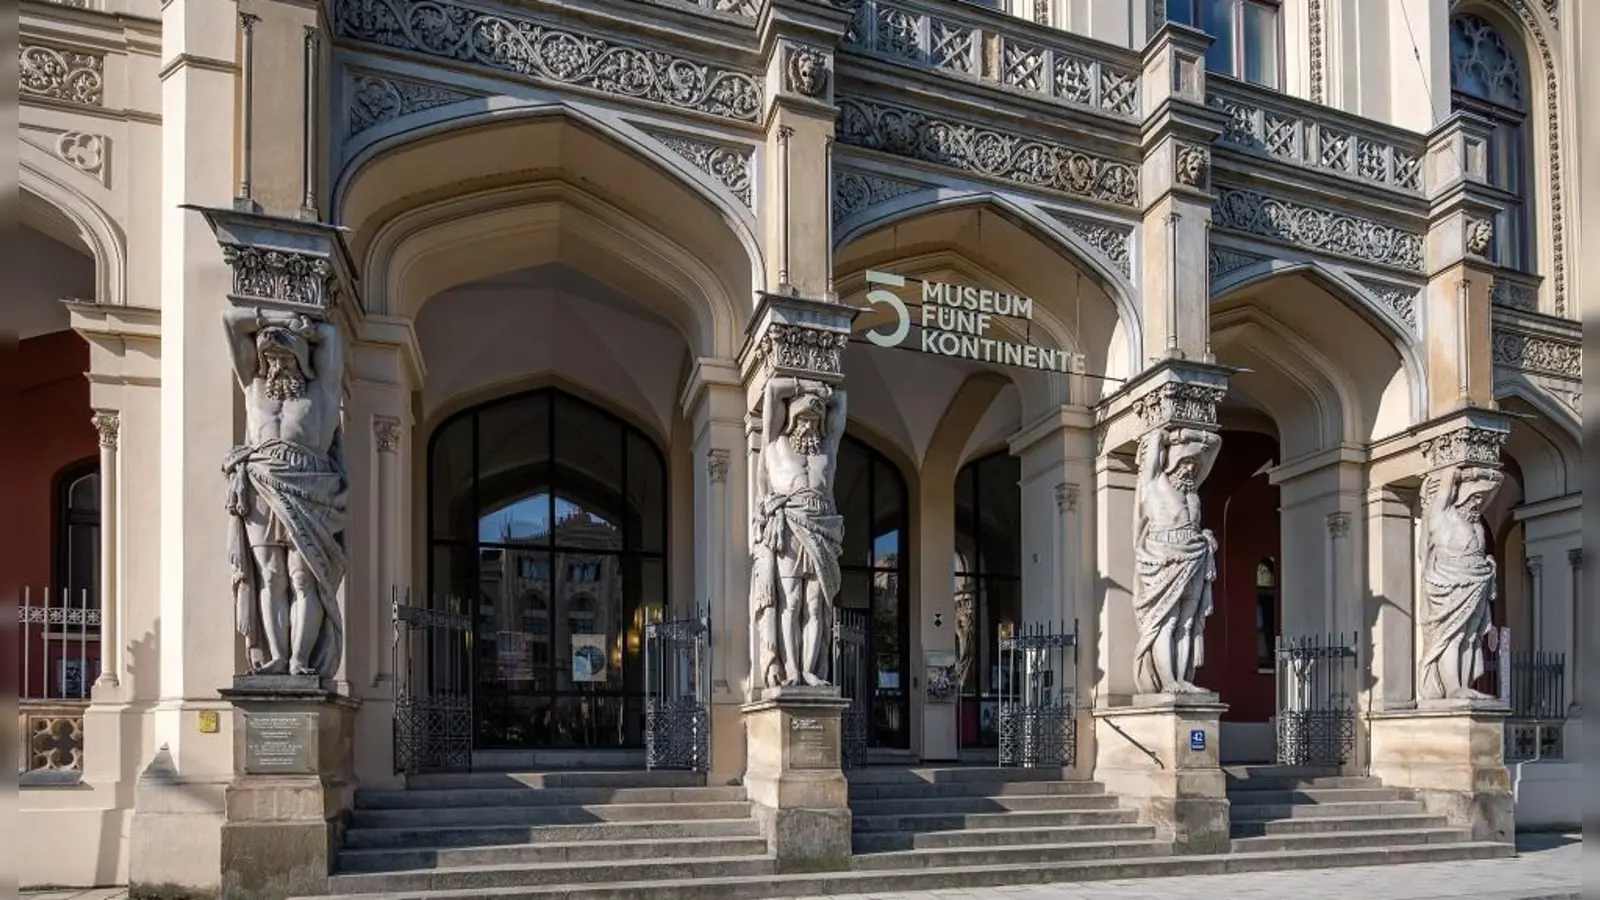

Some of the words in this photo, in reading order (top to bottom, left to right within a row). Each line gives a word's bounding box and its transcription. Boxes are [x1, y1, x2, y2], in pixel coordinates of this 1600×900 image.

[866, 270, 910, 347] 5
[922, 279, 1033, 320] MUSEUM
[922, 305, 992, 336] FÜNF
[922, 329, 1086, 375] KONTINENTE
[1192, 732, 1203, 741] 42
